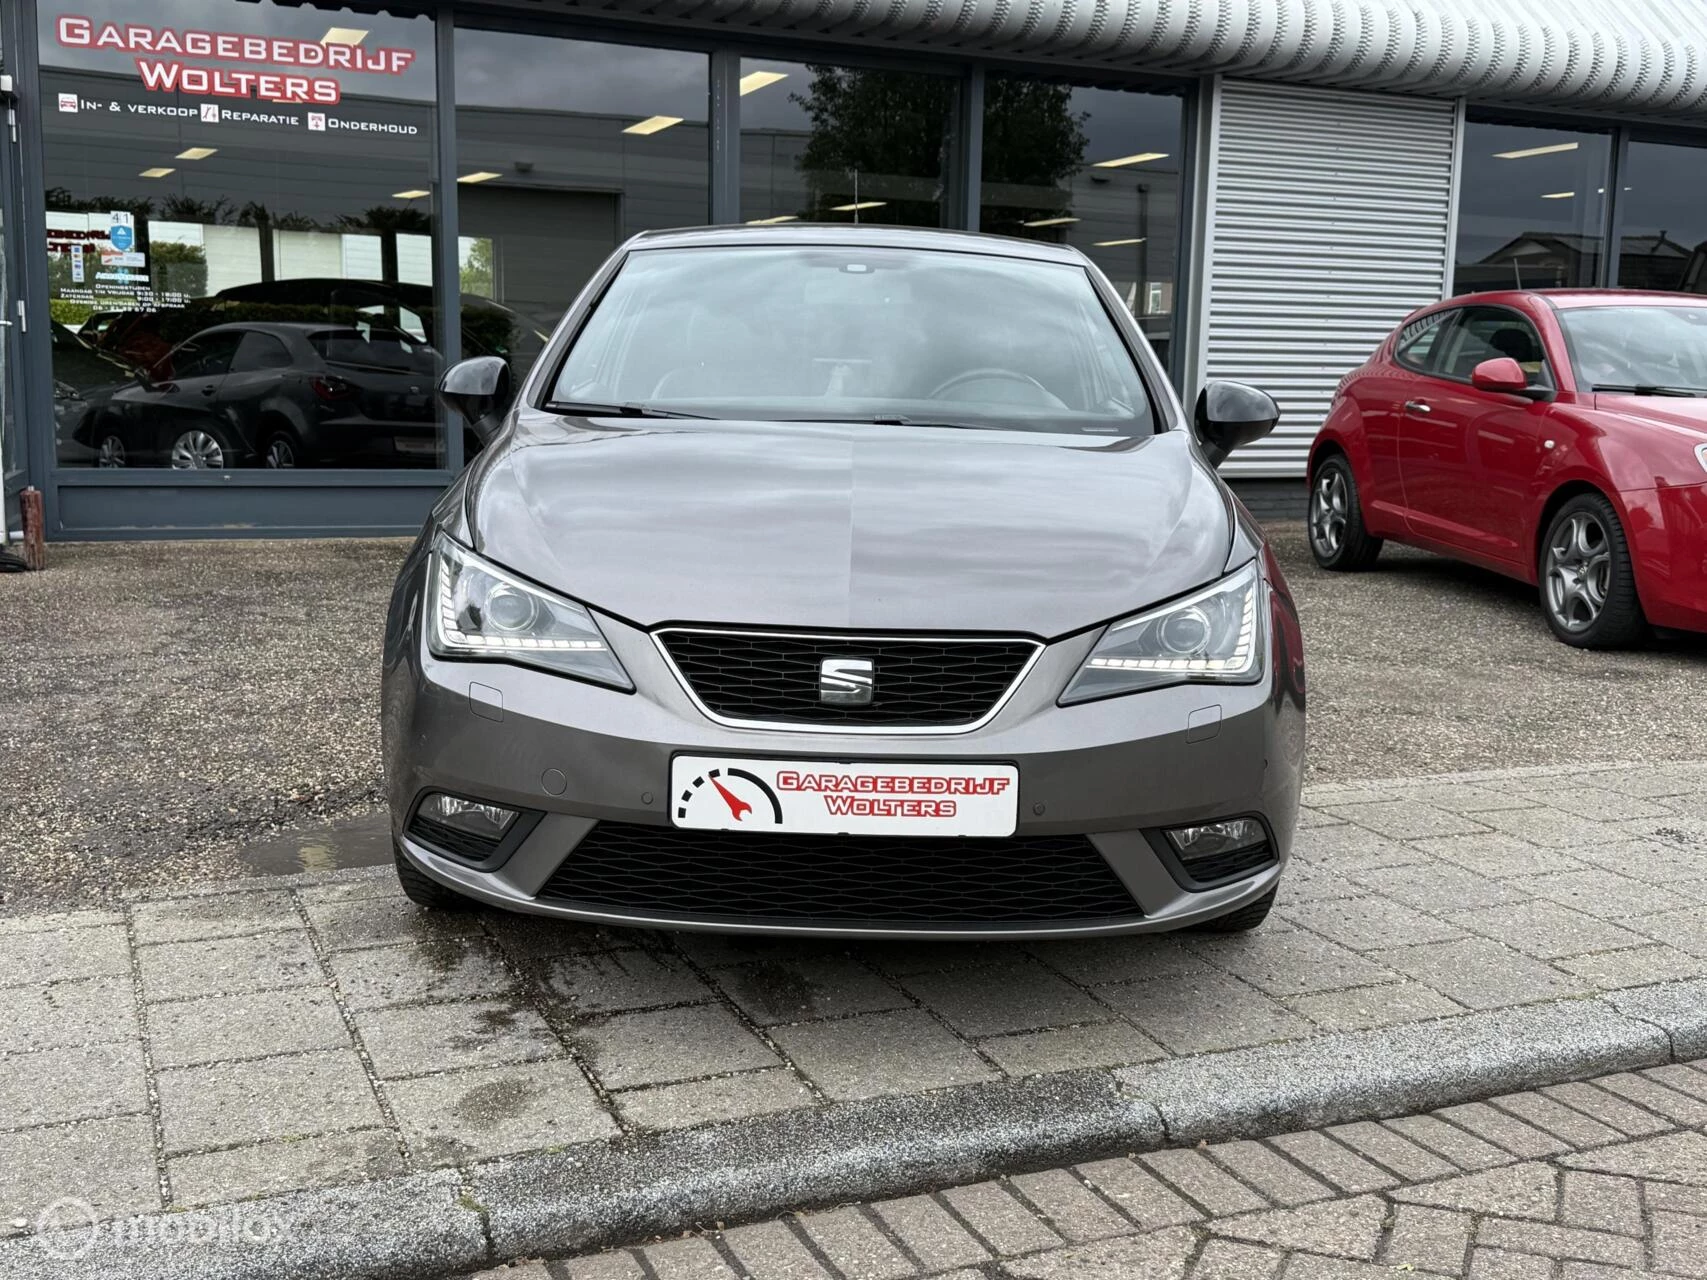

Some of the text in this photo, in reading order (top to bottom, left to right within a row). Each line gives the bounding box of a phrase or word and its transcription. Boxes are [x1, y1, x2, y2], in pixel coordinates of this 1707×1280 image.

[57, 15, 415, 75] GARAGEBEDRIJF
[135, 57, 340, 104] WOLTERS
[109, 101, 121, 112] &
[127, 103, 198, 118] VERKOOP
[221, 108, 300, 126] REPARATIE
[327, 117, 418, 135] ONDERHOUD
[776, 770, 1010, 795] GARAGEBEDRIJF
[824, 795, 957, 817] WOLTERS
